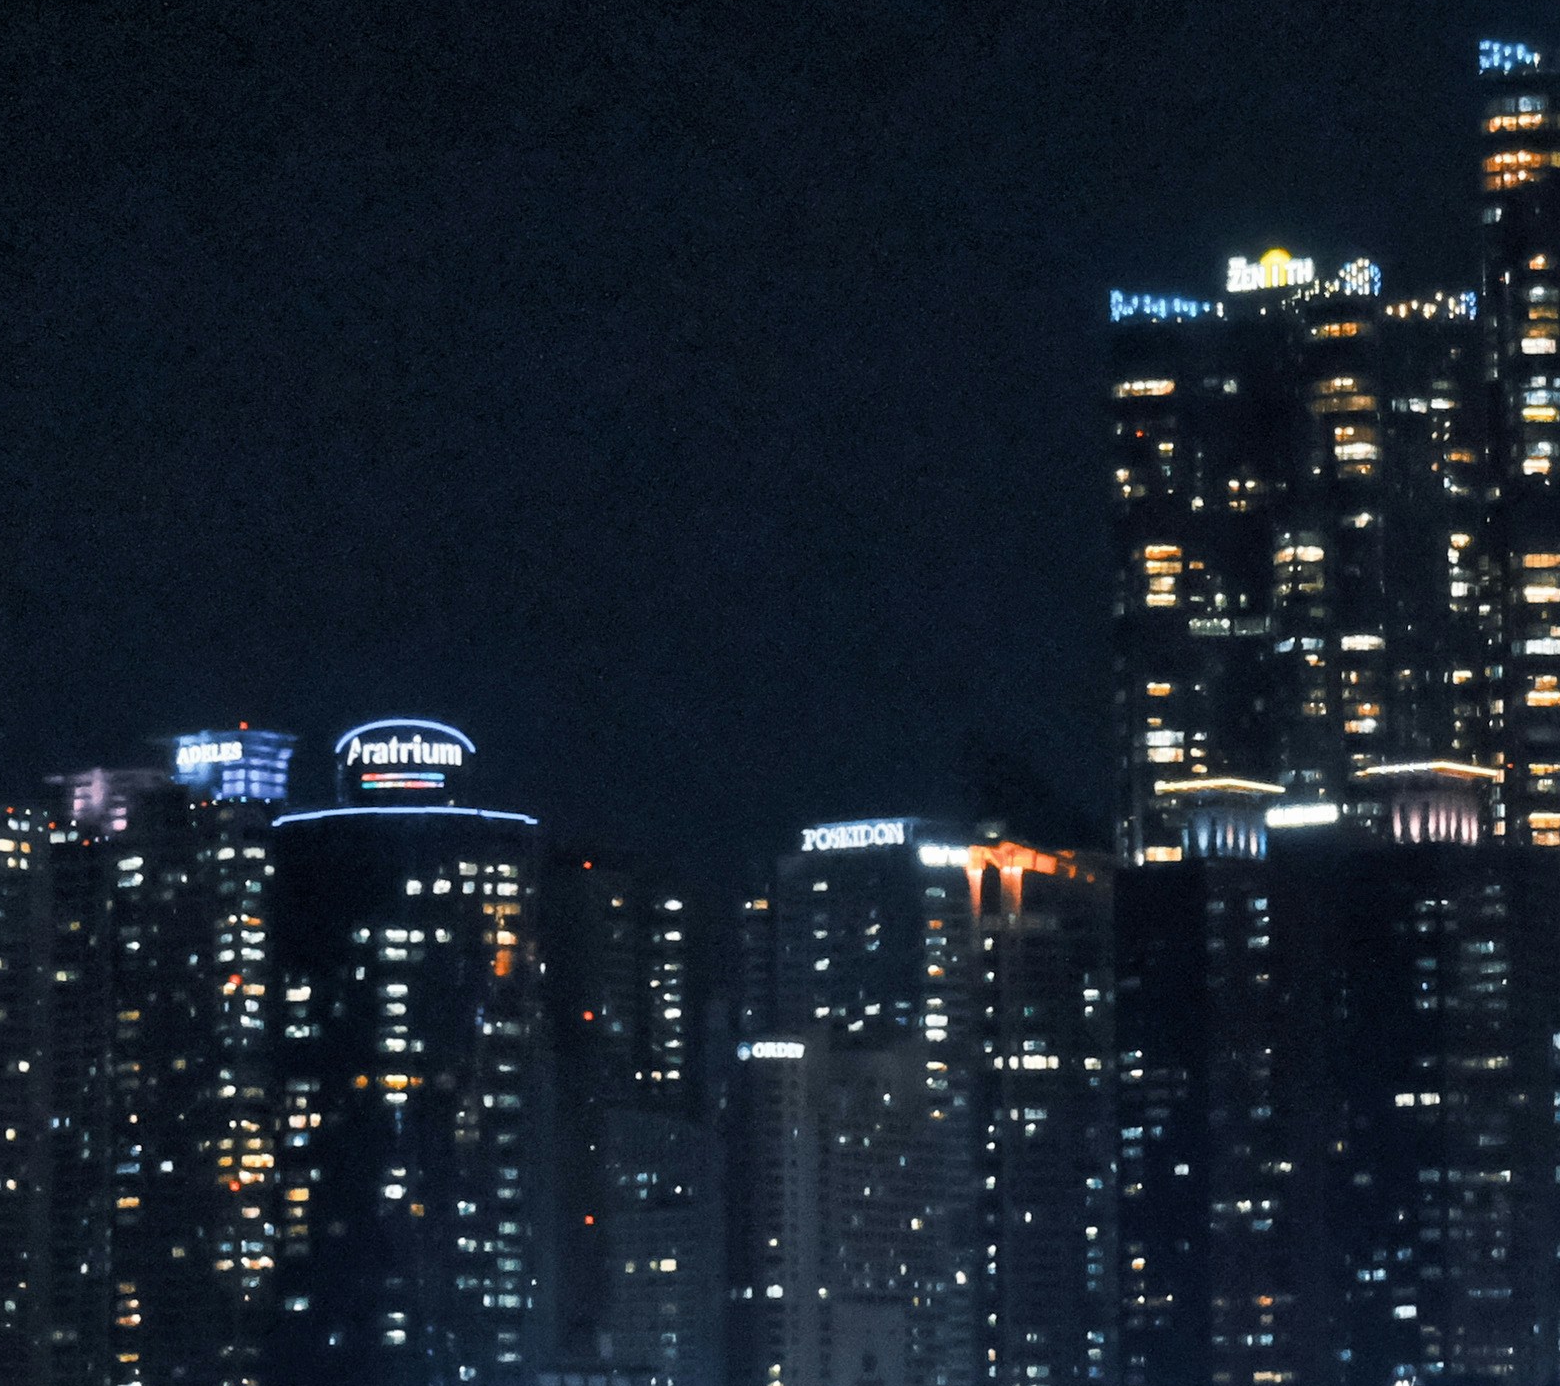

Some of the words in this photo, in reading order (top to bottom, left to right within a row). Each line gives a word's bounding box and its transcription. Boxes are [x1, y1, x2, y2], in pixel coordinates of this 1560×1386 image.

[1227, 258, 1314, 292] ZENITH
[347, 734, 462, 766] Aratrium
[801, 822, 905, 852] POSEIDON
